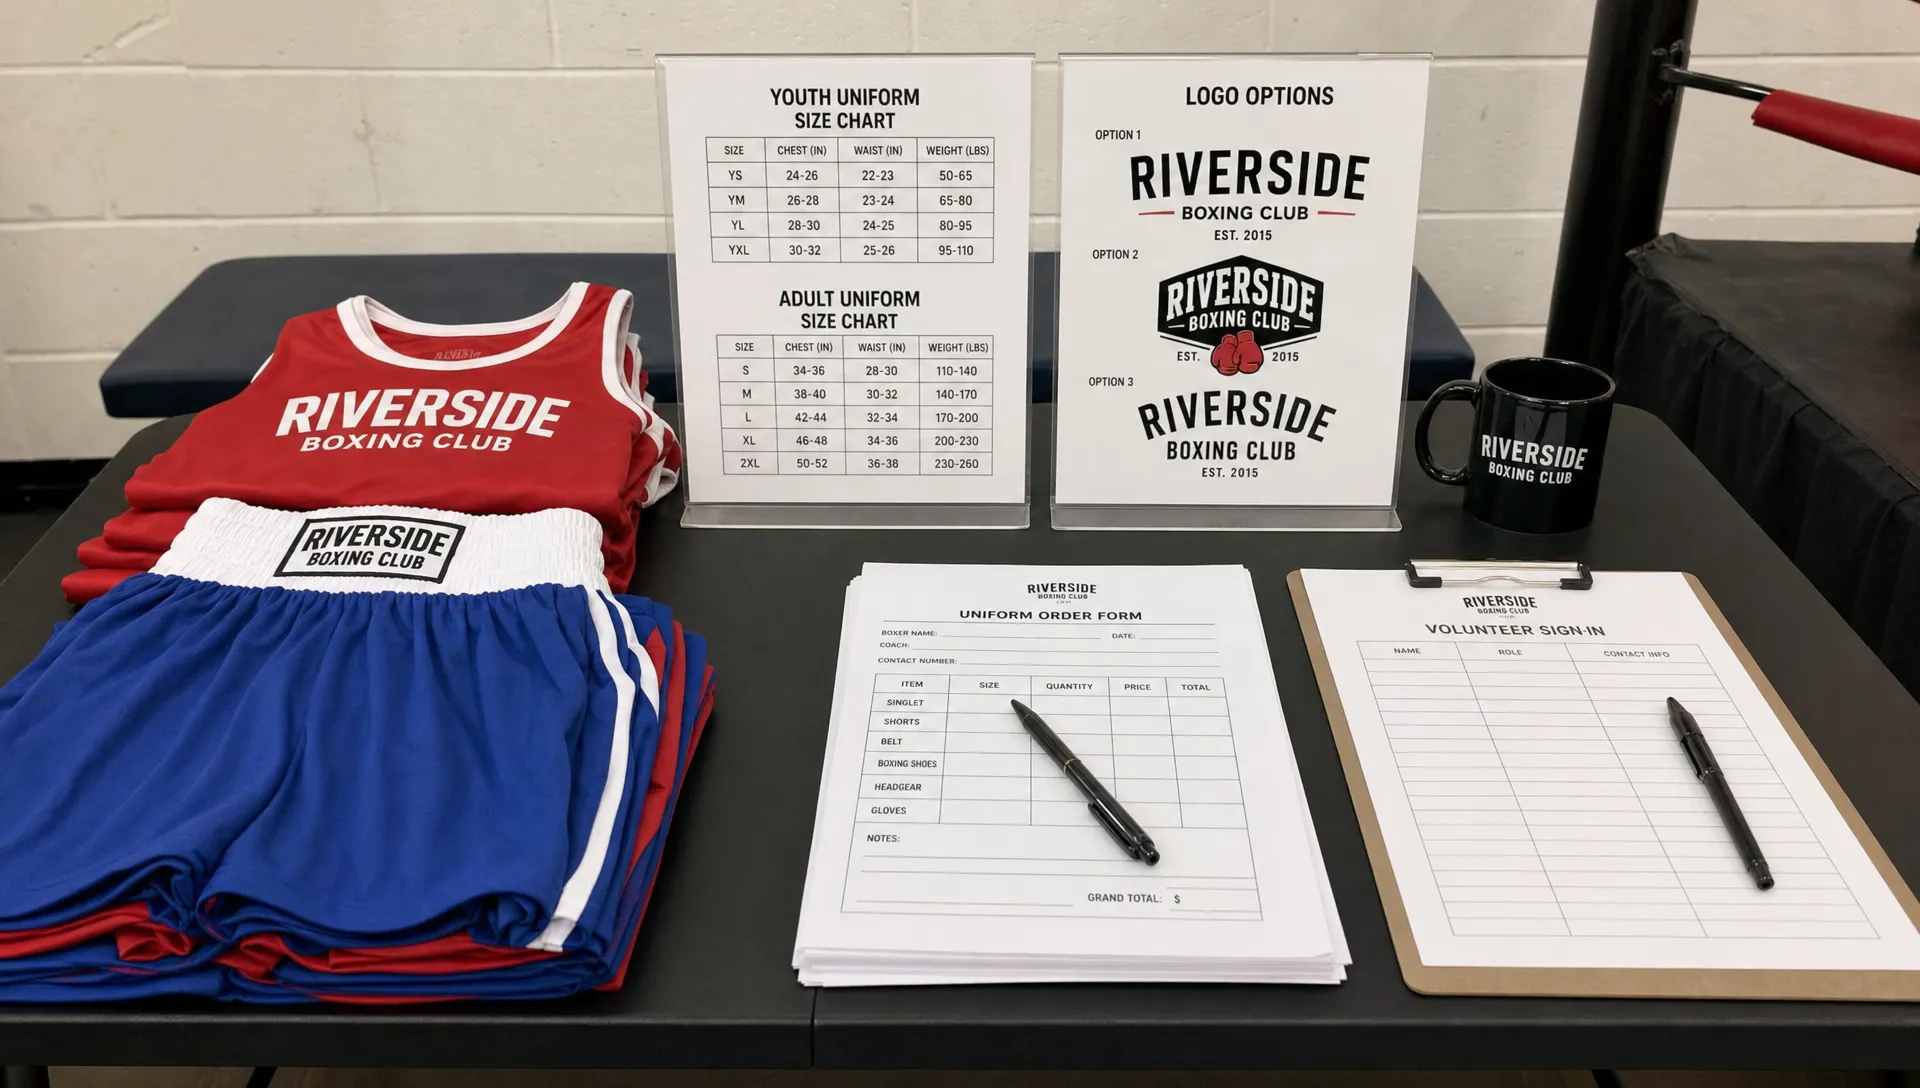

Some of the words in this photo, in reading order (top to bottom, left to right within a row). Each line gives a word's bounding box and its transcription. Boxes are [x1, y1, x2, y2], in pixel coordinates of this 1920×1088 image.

[770, 88, 831, 106] YOUTH
[837, 88, 920, 106] UNIFORM
[1186, 86, 1239, 106] LOGO
[1245, 86, 1334, 106] OPTIONS
[795, 112, 832, 129] SIZE
[837, 112, 896, 129] CHART
[1095, 129, 1134, 141] OPTION
[1136, 129, 1141, 140] 1
[724, 145, 744, 155] SIZE
[777, 145, 808, 155] CHEST
[810, 145, 827, 157] (IN)
[854, 145, 884, 155] WAIST
[885, 145, 903, 157] (IN)
[926, 145, 963, 155] WEIGHT
[965, 145, 990, 157] (LBS)
[728, 170, 743, 181] YS
[786, 170, 819, 181] 24-26
[862, 170, 894, 181] 22-23
[939, 170, 973, 181] 50-65
[1130, 149, 1371, 201] RIVERSIDE
[728, 195, 745, 206] YM
[787, 195, 820, 206] 26-28
[862, 195, 895, 206] 23-24
[939, 195, 973, 206] 65-80
[1182, 206, 1253, 220] BOXING
[1260, 206, 1309, 220] CLUB
[731, 220, 745, 231] YL
[788, 220, 821, 231] 28-30
[863, 220, 895, 231] 24-25
[939, 220, 972, 231] 80-95
[1214, 230, 1239, 241] EST.
[1244, 229, 1272, 241] 2015
[728, 245, 750, 256] YXL
[789, 245, 821, 256] 30-32
[863, 245, 895, 256] 25-26
[938, 245, 974, 256] 95-110
[1092, 249, 1130, 260] OPTION
[1132, 249, 1139, 259] 2
[779, 290, 835, 307] ADULT
[840, 290, 920, 307] UNIFORM
[1166, 266, 1317, 323] RIVERSIDE
[801, 313, 837, 329] SIZE
[841, 313, 898, 329] CHART
[1189, 309, 1247, 332] BOXING
[1252, 310, 1291, 332] CLUB
[735, 342, 755, 352] SIZE
[785, 342, 814, 352] CHEST
[816, 342, 833, 353] (IN)
[858, 343, 887, 353] WAIST
[889, 342, 906, 354] (IN)
[928, 343, 964, 353] WEIGHT
[966, 343, 989, 354] (LBS)
[1177, 351, 1200, 362] EST.
[1272, 352, 1299, 362] 2015
[742, 366, 749, 376] S
[793, 365, 825, 376] 34-36
[866, 365, 898, 376] 28-30
[936, 366, 978, 377] 110-140
[1088, 377, 1126, 387] OPTION
[1128, 377, 1134, 386] 3
[742, 389, 752, 399] M
[794, 389, 827, 399] 38-40
[866, 389, 898, 400] 30-32
[935, 389, 978, 400] 140-170
[275, 388, 571, 438] RIVERSIDE
[745, 413, 752, 423] L
[795, 413, 827, 423] 42-44
[867, 413, 898, 423] 32-34
[935, 413, 979, 423] 170-200
[1137, 390, 1337, 443] RIVERSIDE
[299, 432, 425, 452] BOXING
[432, 433, 513, 452] CLUB
[742, 436, 756, 446] XL
[796, 436, 828, 446] 46-48
[867, 436, 899, 446] 34-36
[934, 436, 979, 447] 200-230
[1167, 440, 1239, 460] BOXING
[1246, 441, 1296, 460] CLUB
[1481, 434, 1588, 471] RIVERSIDE
[740, 458, 760, 468] 2XL
[796, 458, 828, 469] 50-52
[867, 458, 899, 469] 36-38
[934, 458, 979, 469] 230-260
[1202, 467, 1226, 478] EST.
[1230, 467, 1259, 478] 2015
[1488, 461, 1535, 482] BOXING
[1539, 471, 1573, 485] CLUB
[301, 524, 451, 557] RIVERSIDE
[306, 550, 374, 566] BOXING
[377, 551, 425, 570] CLUB
[1027, 582, 1097, 595] RIVERSIDE
[1462, 595, 1539, 609] RIVERSIDE
[960, 610, 1033, 620] UNIFORM
[1038, 610, 1092, 621] ORDER
[1098, 611, 1143, 621] FORM
[1425, 624, 1535, 636] VOLUNTEER
[1539, 625, 1606, 636] SIGN-IN
[1604, 650, 1646, 658] CONTACT
[1648, 651, 1670, 659] INFO
[877, 657, 917, 665] CONTACT
[901, 680, 924, 688] ITEM
[979, 681, 1000, 689] SIZE
[1046, 682, 1094, 691] QUANTITY
[886, 699, 925, 707] SINGLET
[884, 718, 920, 726] SHORTS
[880, 738, 903, 746] BELT
[878, 760, 909, 768] BOXING
[910, 760, 937, 768] SHOES
[874, 783, 923, 792] HEADGEAR
[870, 806, 907, 815] GLOVES
[866, 834, 900, 843] NOTES:
[1087, 893, 1124, 903] GRAND
[1127, 894, 1163, 904] TOTAL:
[1174, 894, 1181, 904] $
